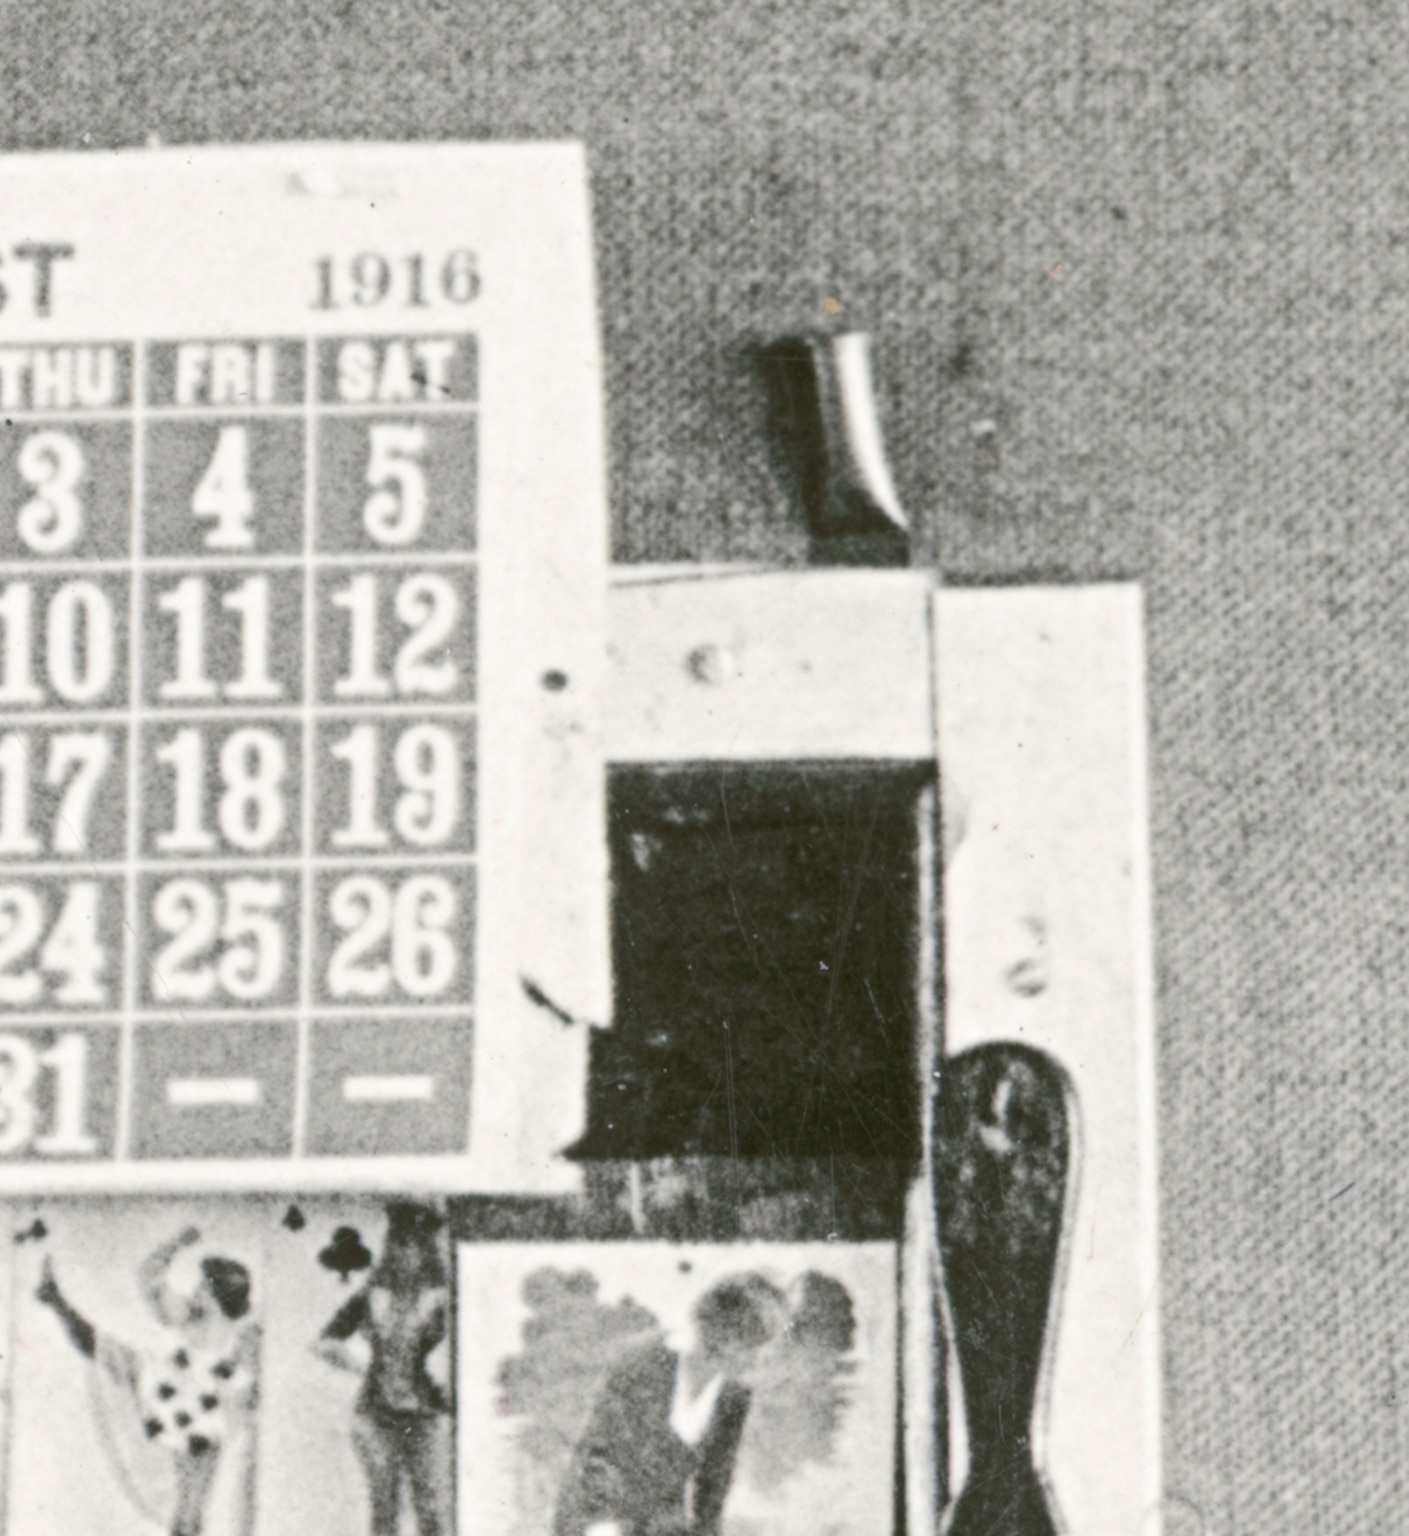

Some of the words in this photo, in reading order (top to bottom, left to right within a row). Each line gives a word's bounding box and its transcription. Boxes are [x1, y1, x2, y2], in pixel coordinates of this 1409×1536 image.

[313, 253, 482, 311] 1916
[166, 347, 276, 407] FRI
[339, 343, 456, 403] SAT
[18, 431, 85, 553] 3
[193, 426, 254, 548] 4
[364, 424, 428, 544] 5
[159, 576, 281, 698] 11
[333, 573, 459, 696] 12
[157, 729, 286, 851] 18
[332, 726, 460, 846] 19
[153, 878, 284, 1000] 25
[328, 876, 457, 996] 26
